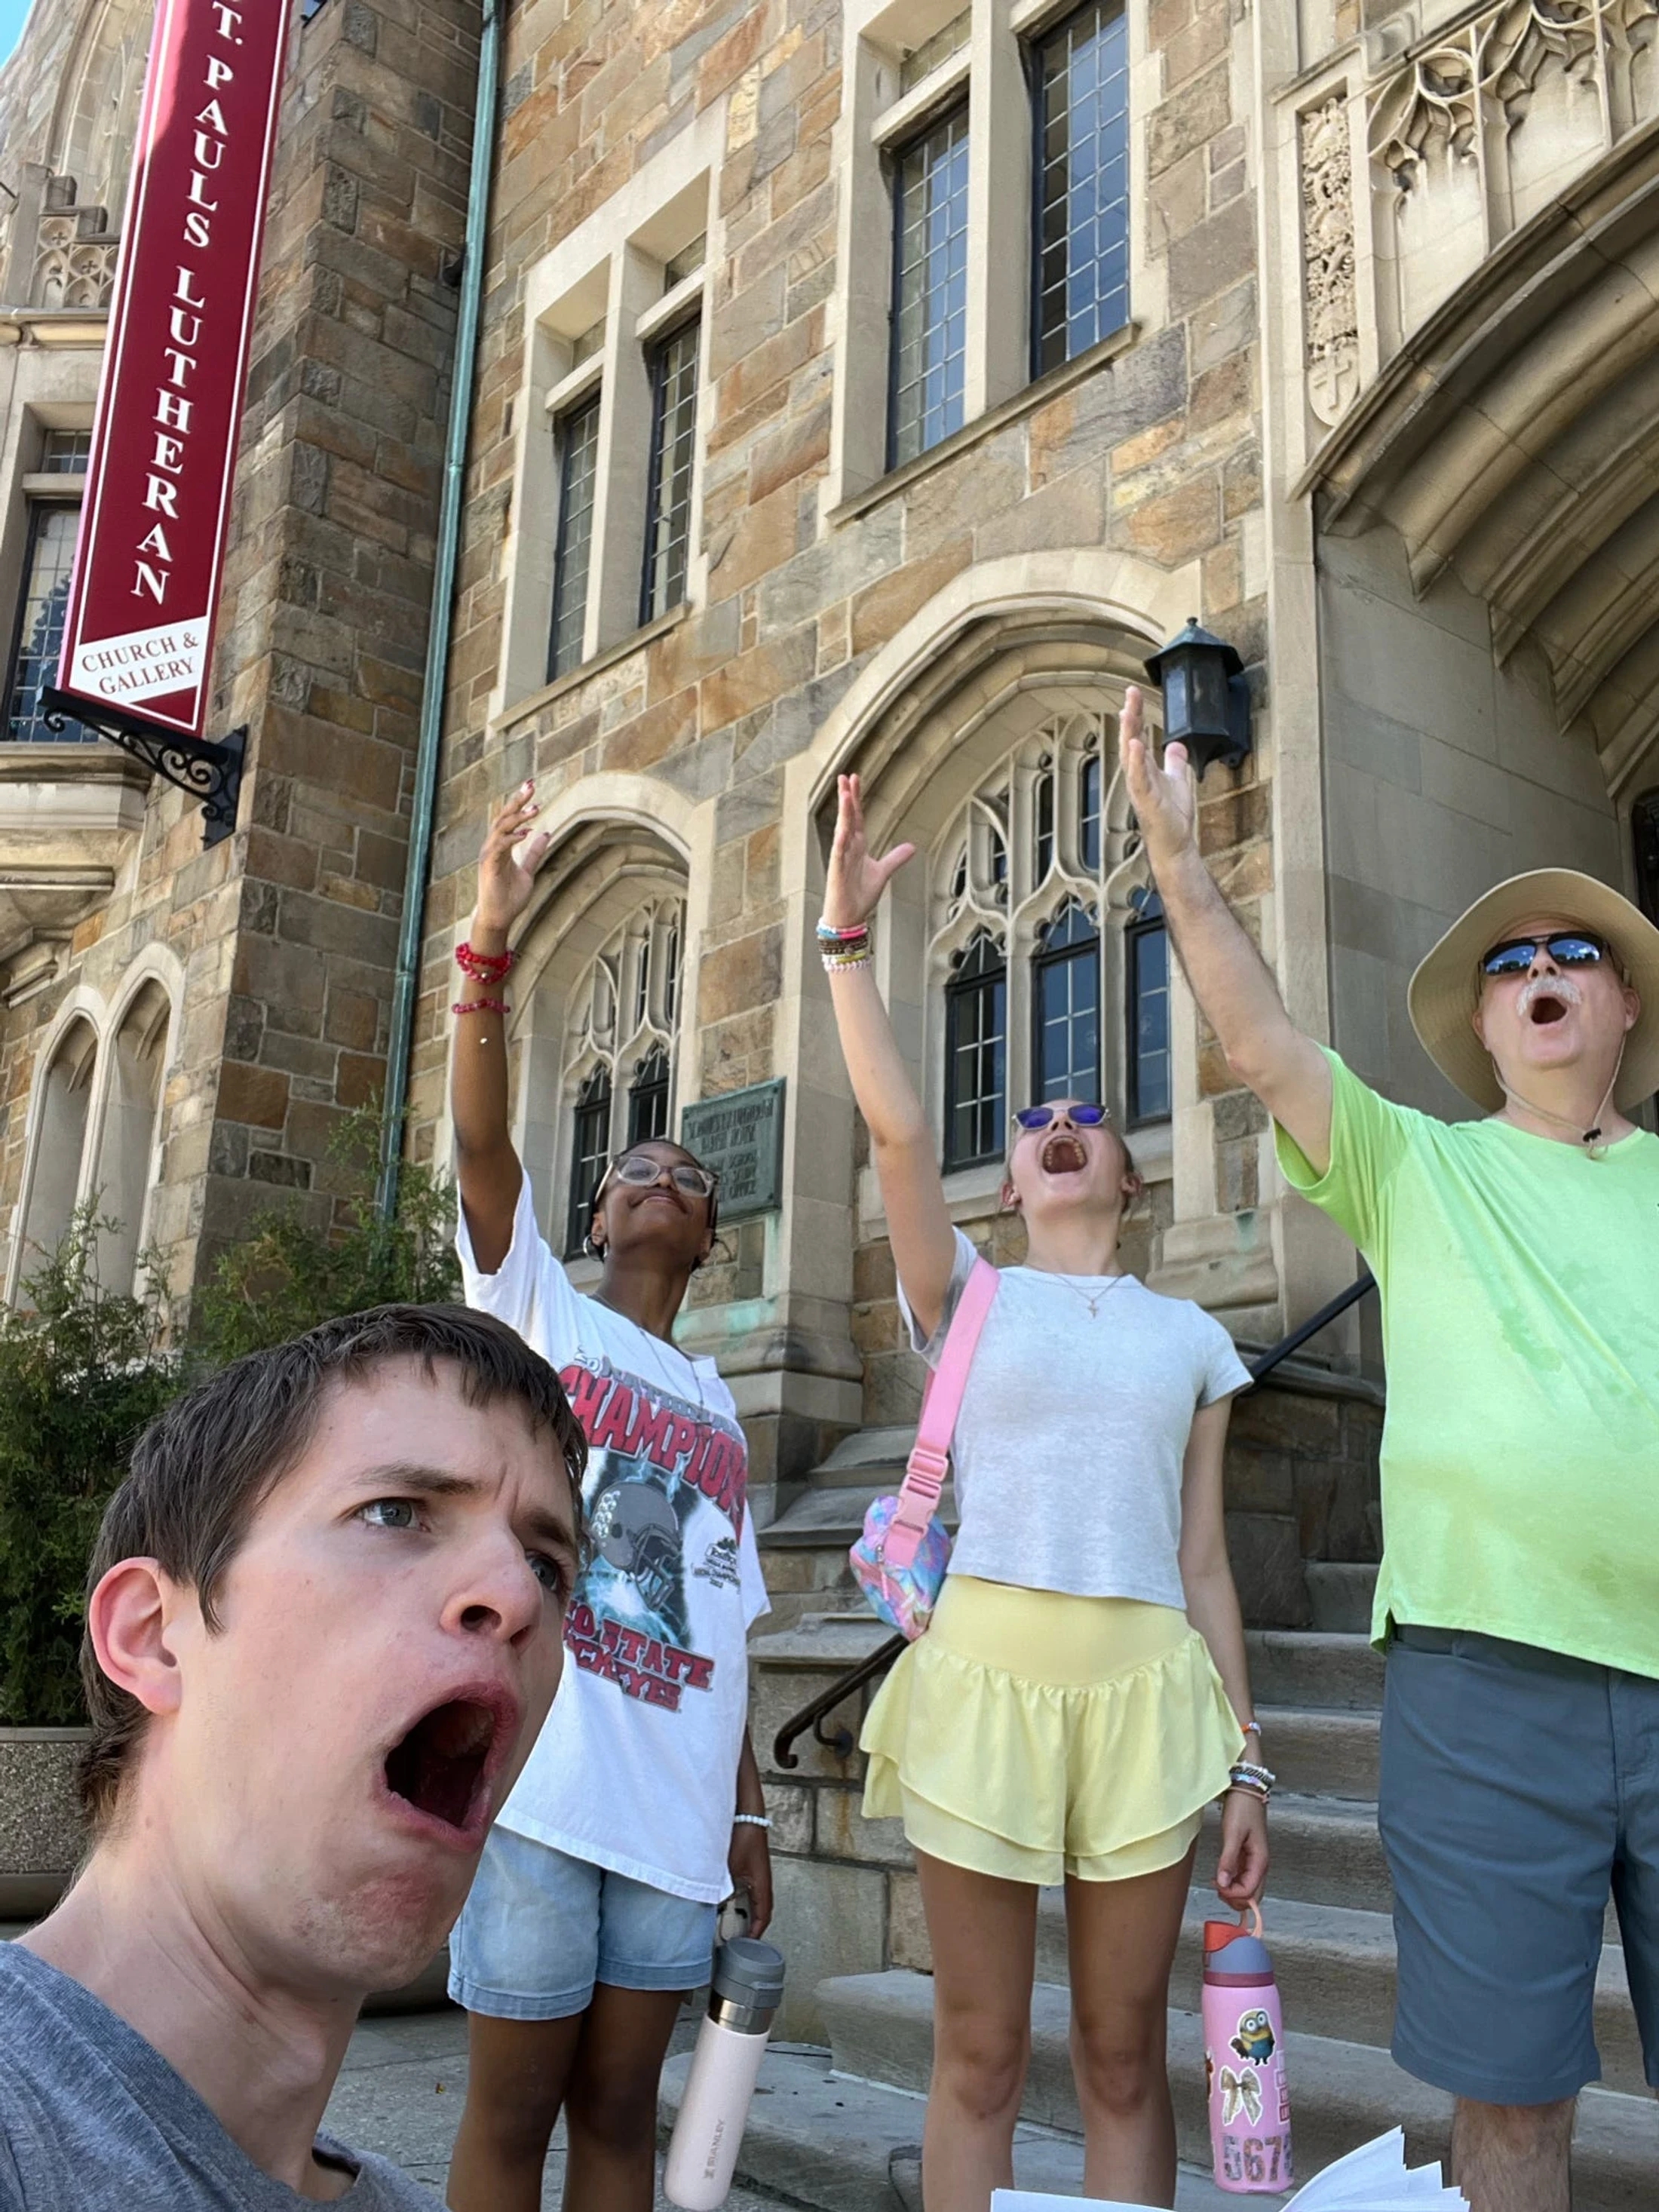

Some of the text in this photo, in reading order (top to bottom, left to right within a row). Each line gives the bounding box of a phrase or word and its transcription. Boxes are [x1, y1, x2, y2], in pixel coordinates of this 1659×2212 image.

[130, 0, 243, 605] T. PAULS LUTHERAN
[81, 631, 198, 673] CHURCH &
[98, 655, 195, 695] GALLERY
[601, 1618, 715, 1689] STATE
